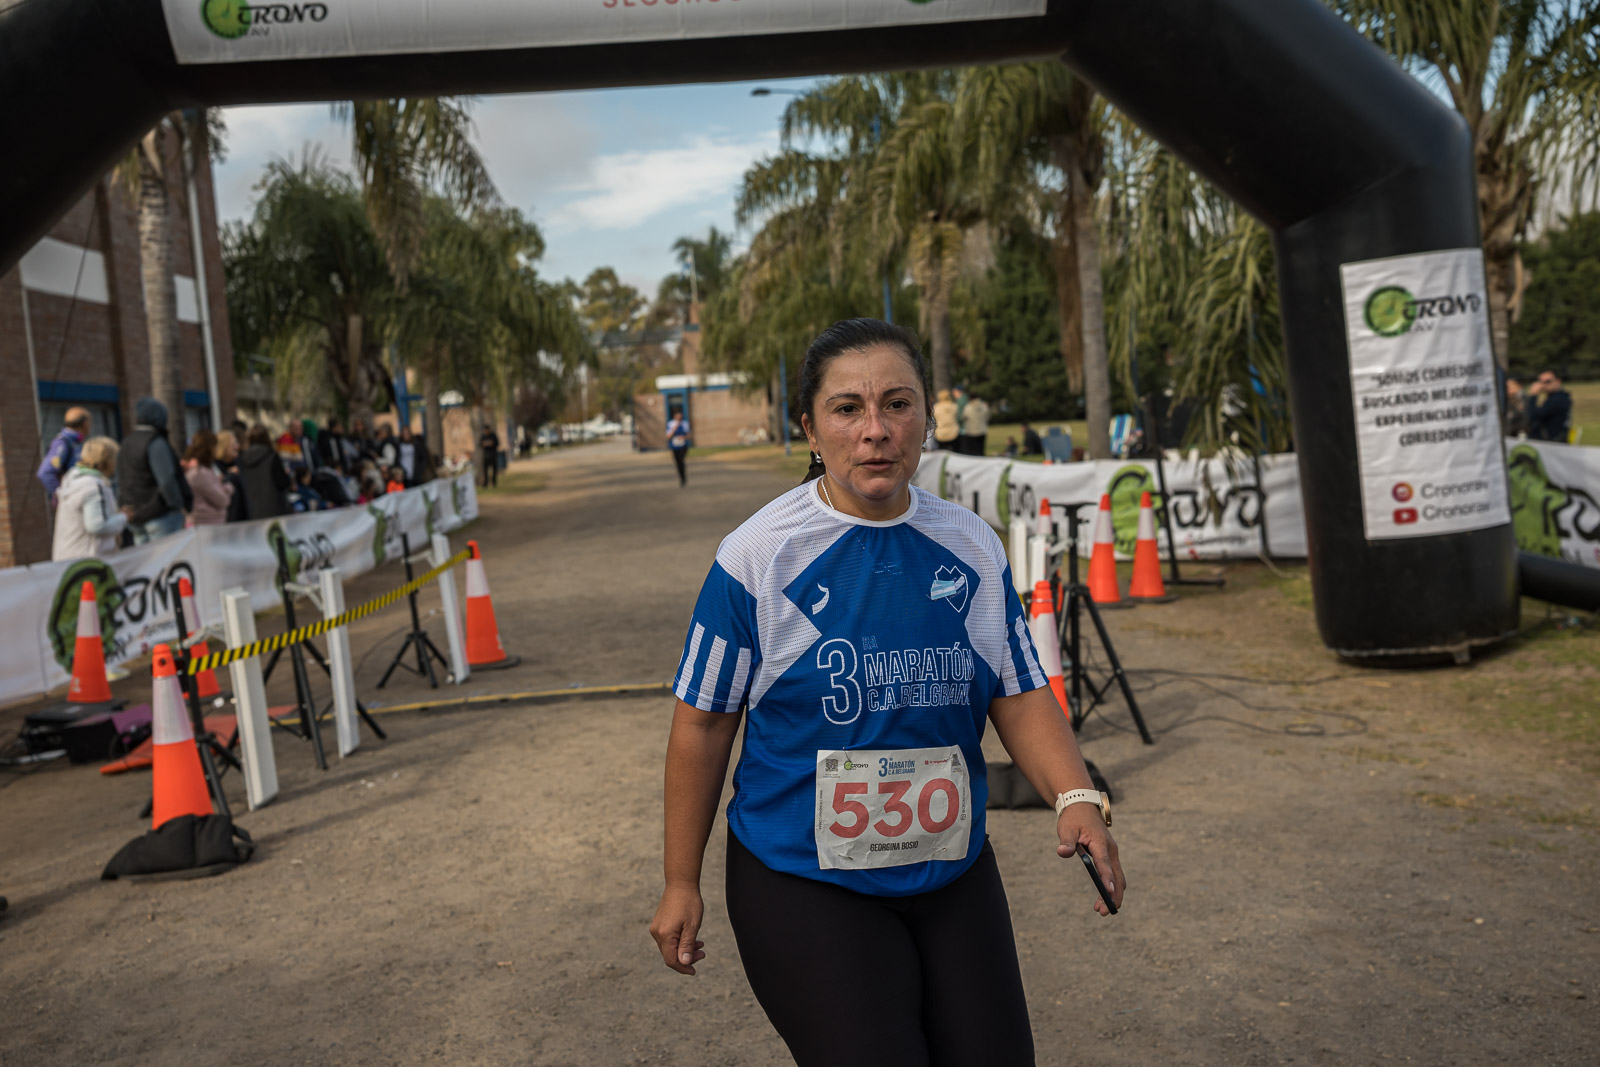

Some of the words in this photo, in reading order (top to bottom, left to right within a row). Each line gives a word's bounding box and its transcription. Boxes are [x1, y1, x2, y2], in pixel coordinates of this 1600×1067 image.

[816, 638, 863, 726] 3
[863, 641, 975, 688] MARATÓN
[888, 759, 916, 770] MARATÓN
[828, 777, 960, 839] 530
[870, 842, 900, 852] GEORGINA
[901, 840, 919, 850] BOSIO
